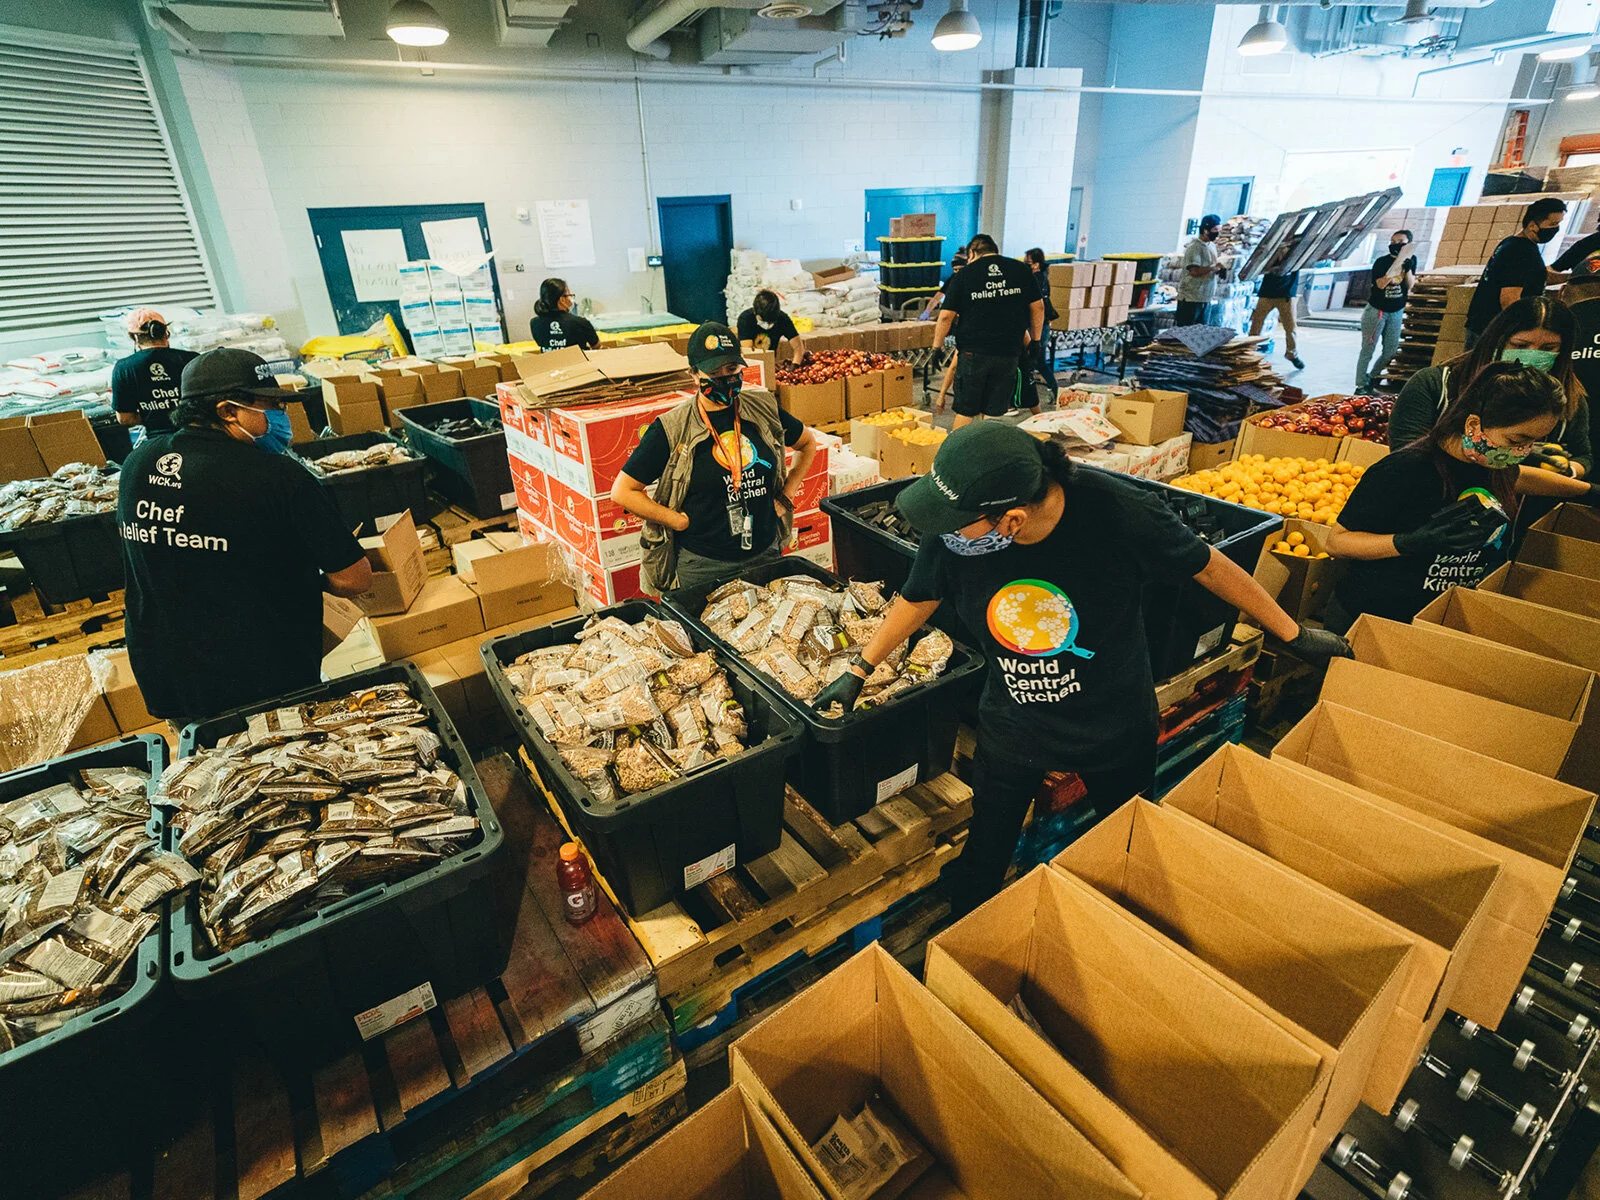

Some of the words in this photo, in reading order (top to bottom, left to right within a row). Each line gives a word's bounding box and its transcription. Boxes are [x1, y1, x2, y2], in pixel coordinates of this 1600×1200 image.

[986, 280, 1006, 289] Chef
[971, 290, 996, 300] Relief
[998, 288, 1021, 296] Team
[1571, 347, 1600, 360] elie
[152, 387, 179, 398] Chef
[148, 474, 182, 489] WCK.org
[723, 468, 755, 484] Wrld
[727, 476, 764, 492] Cntral
[810, 482, 827, 508] apples
[934, 475, 959, 500] happy
[136, 500, 184, 523] Chef
[163, 528, 228, 552] Team
[1435, 550, 1481, 563] World
[1428, 563, 1487, 576] Centra
[997, 656, 1059, 674] World
[1004, 668, 1076, 690] Central
[1008, 681, 1081, 704] Kitchen
[568, 892, 584, 908] G
[832, 1132, 850, 1156] Health
